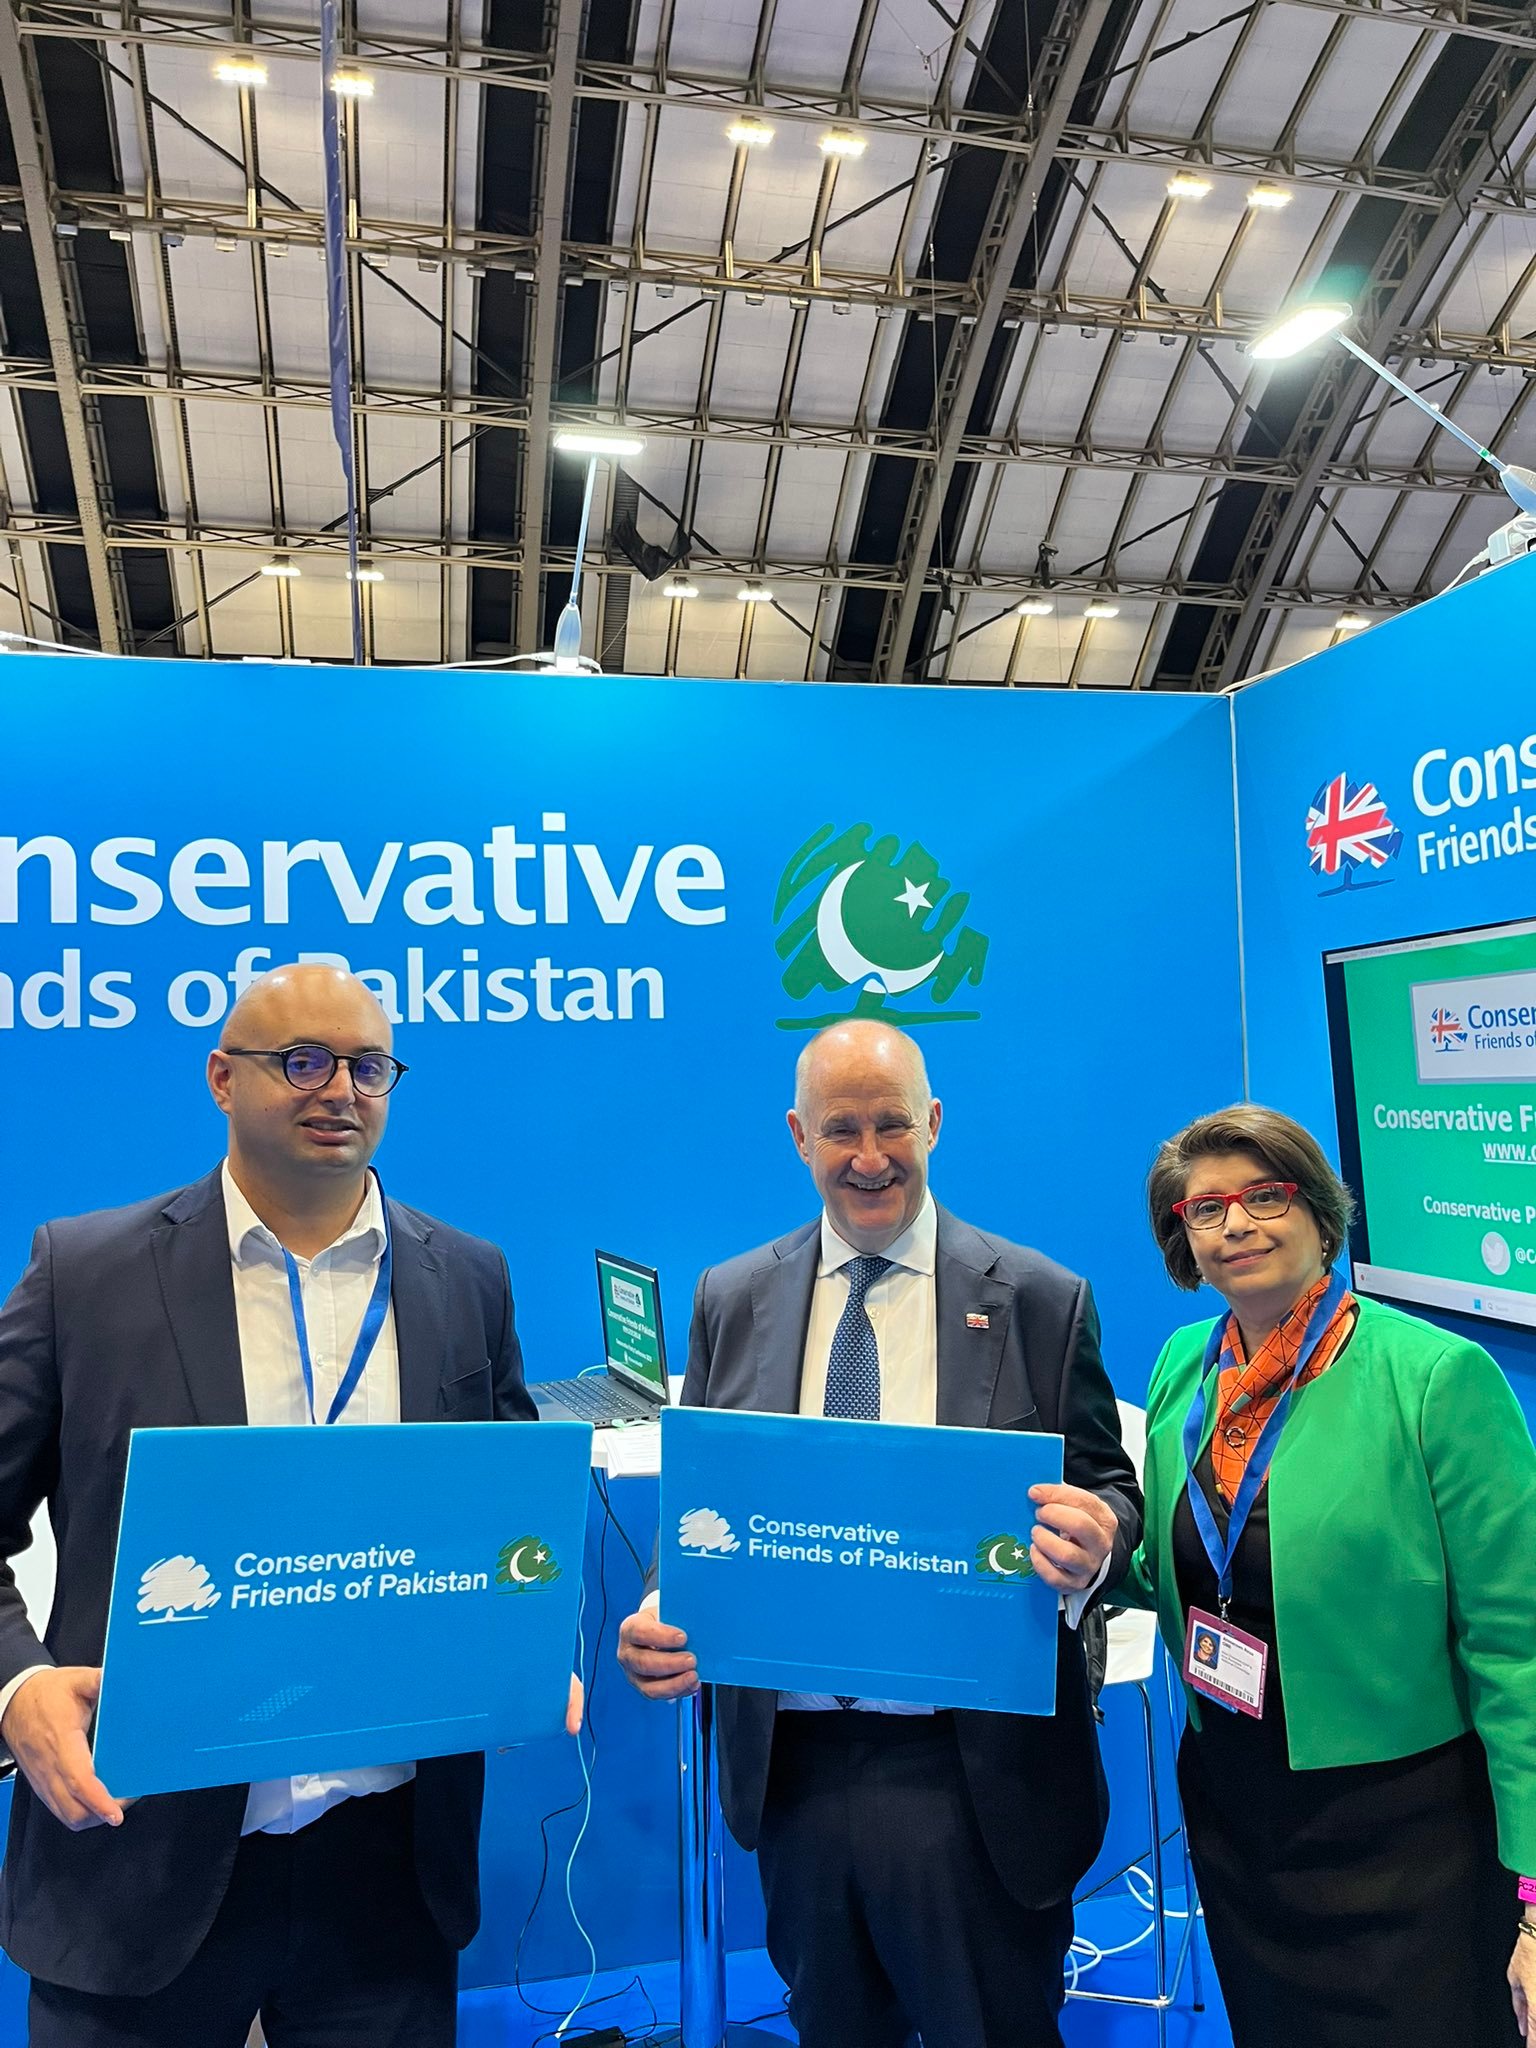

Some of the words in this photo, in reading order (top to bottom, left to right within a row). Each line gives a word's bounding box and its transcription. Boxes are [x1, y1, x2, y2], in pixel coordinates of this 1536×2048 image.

[297, 947, 664, 1024] akistan
[1475, 1031, 1522, 1049] Friends
[1374, 1103, 1513, 1132] Conservative
[1423, 1196, 1522, 1223] Conservative
[748, 1514, 900, 1545] Conservative
[234, 1543, 416, 1578] Conservative
[747, 1538, 833, 1564] Friends
[838, 1547, 863, 1567] of
[868, 1550, 969, 1575] Pakistan
[231, 1578, 336, 1609] Friends
[344, 1576, 372, 1600] of
[379, 1569, 488, 1597] Pakistan
